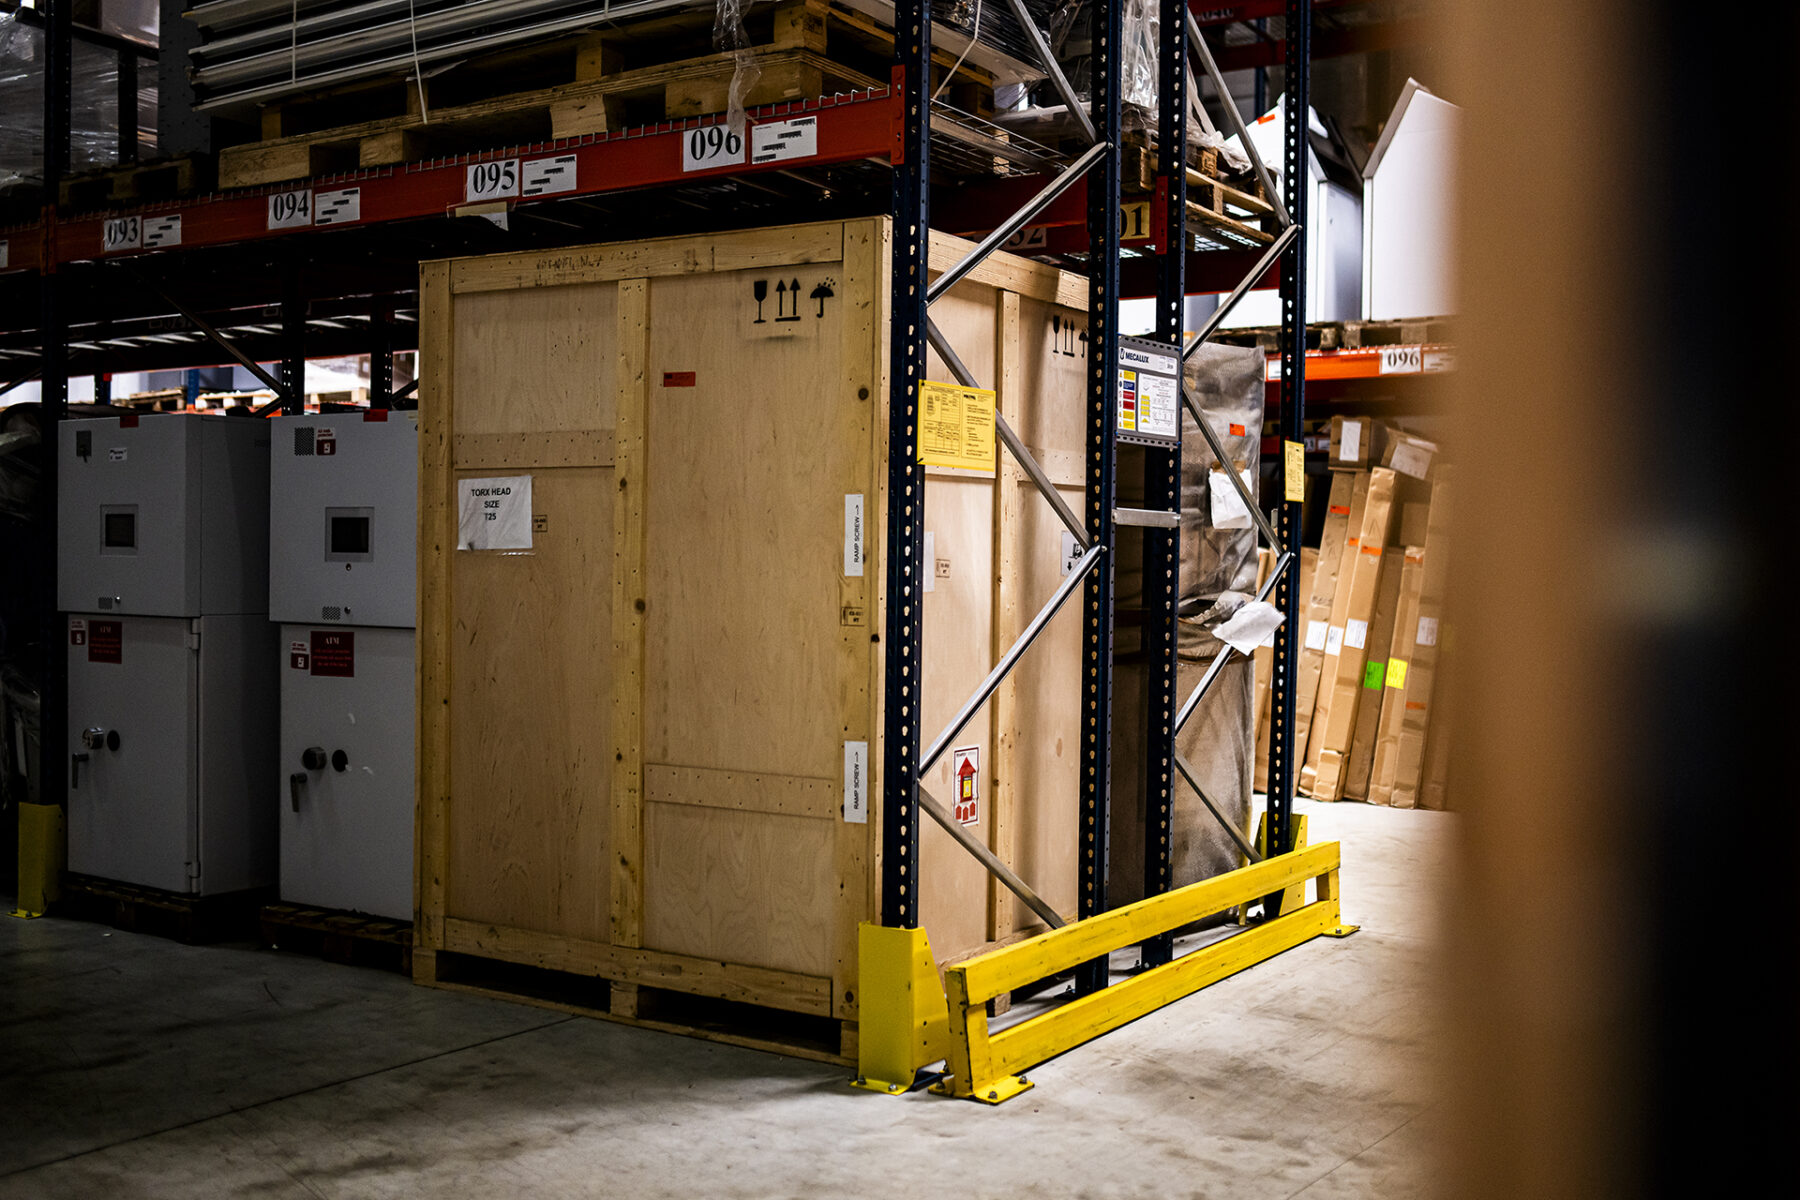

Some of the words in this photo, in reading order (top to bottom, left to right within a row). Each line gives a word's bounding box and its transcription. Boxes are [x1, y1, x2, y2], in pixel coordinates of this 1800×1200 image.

[690, 126, 742, 161] 096
[473, 161, 516, 194] 095
[273, 190, 309, 222] 094
[108, 217, 138, 245] 093
[1125, 352, 1149, 363] MECALUX
[1387, 351, 1419, 367] 096
[471, 488, 490, 497] TORX
[491, 487, 511, 496] HEAD
[484, 500, 499, 509] SIZE
[484, 512, 497, 521] T25
